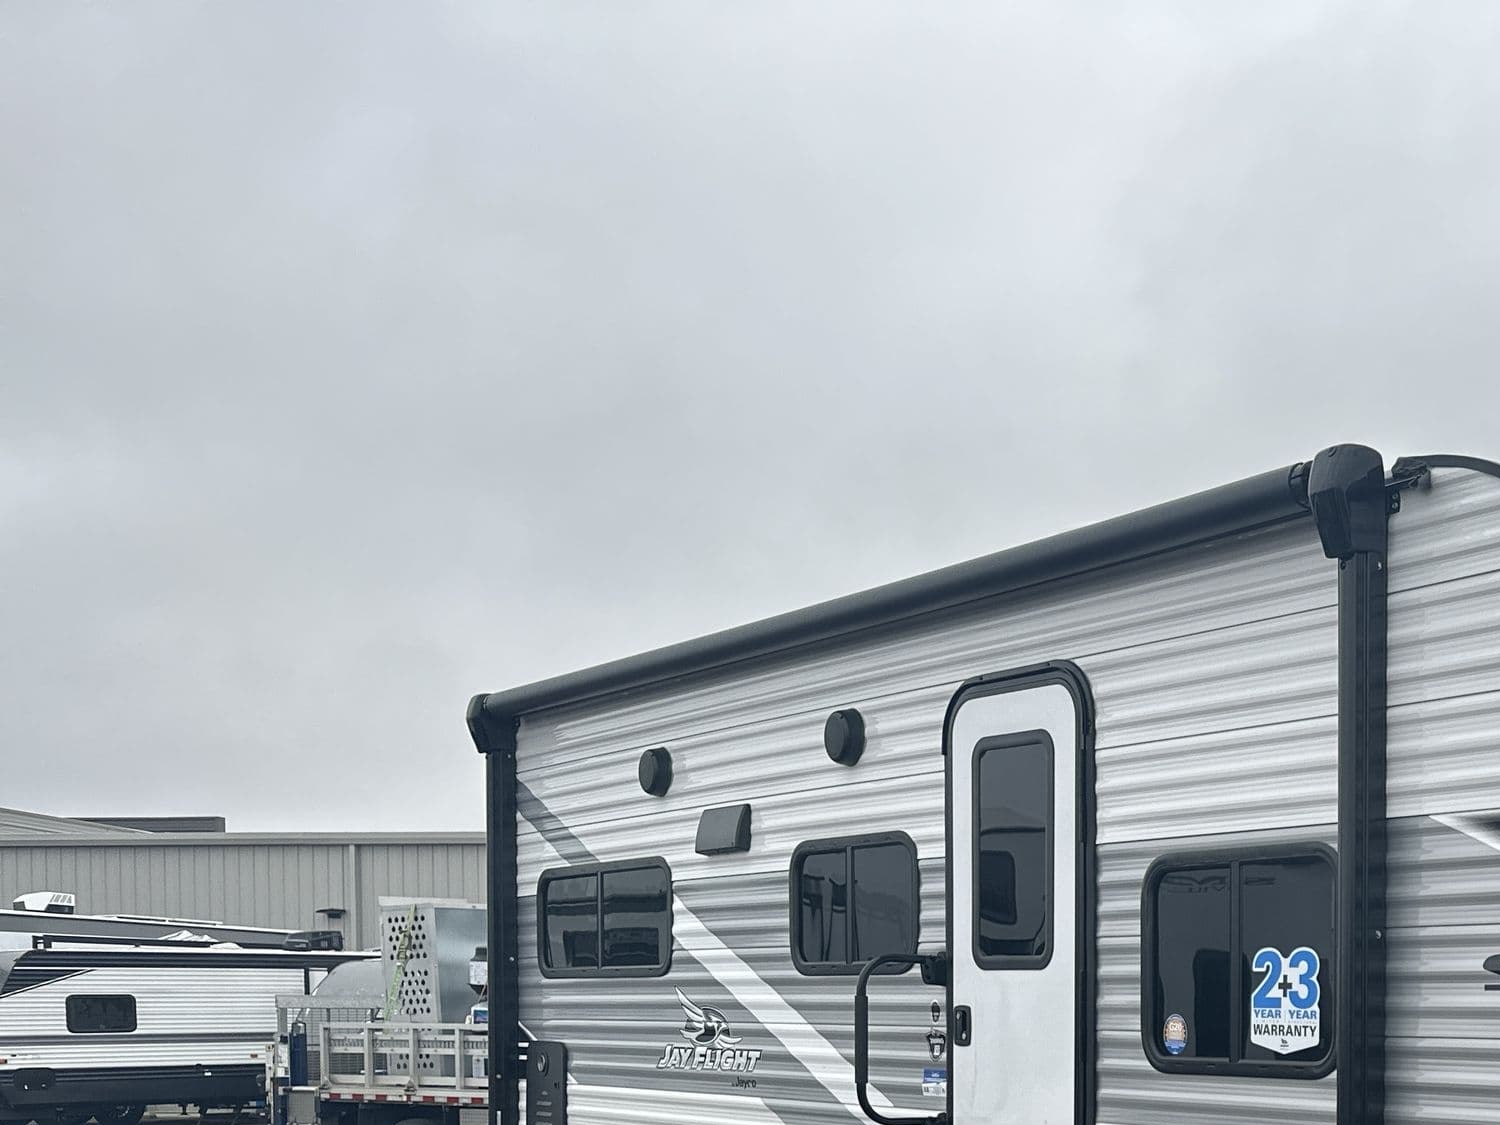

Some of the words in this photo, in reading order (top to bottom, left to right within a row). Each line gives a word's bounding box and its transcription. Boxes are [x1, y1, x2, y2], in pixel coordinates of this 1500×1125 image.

[1254, 1009, 1281, 1019] YEAR
[1288, 1010, 1317, 1020] YEAR
[1253, 1024, 1317, 1037] WARRANTY
[656, 1043, 693, 1070] JAY
[691, 1046, 763, 1073] FLIGHT
